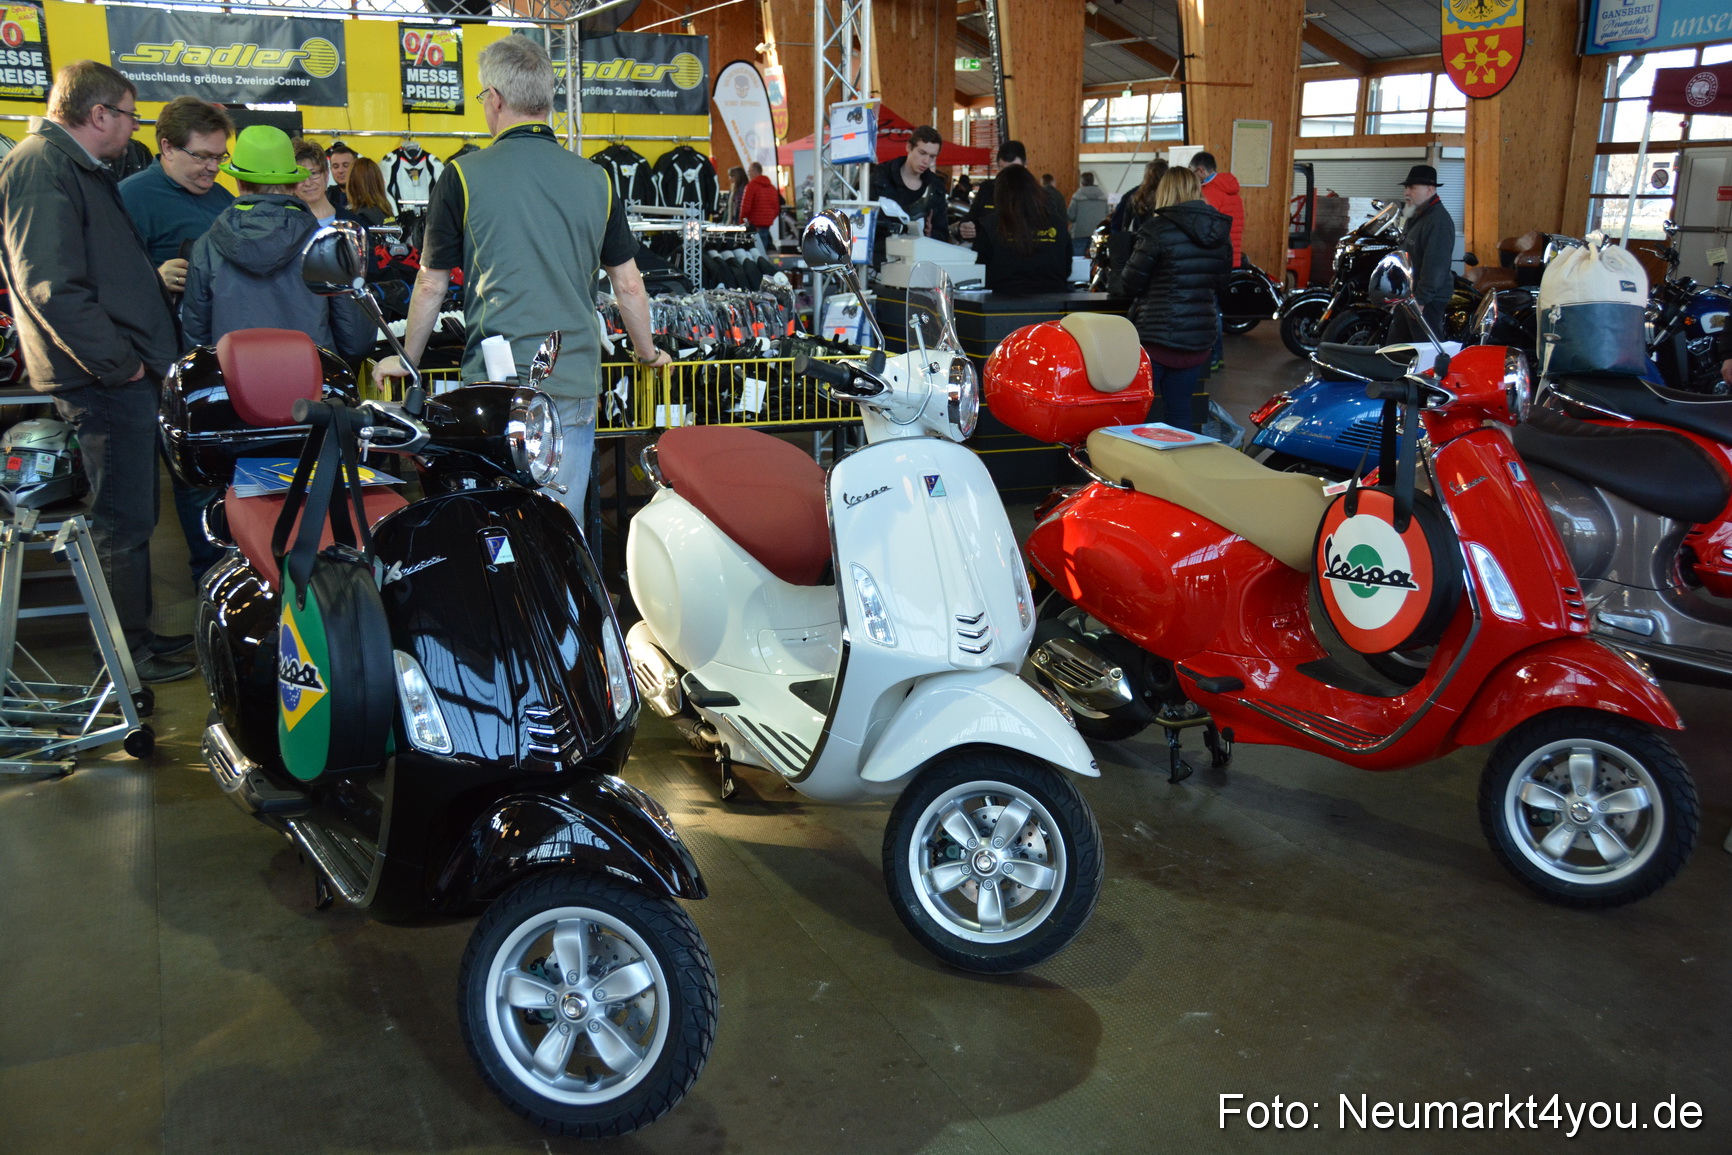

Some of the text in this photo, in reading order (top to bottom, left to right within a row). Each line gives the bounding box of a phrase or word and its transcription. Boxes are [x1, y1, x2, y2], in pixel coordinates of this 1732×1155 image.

[0, 49, 44, 67] ESSE
[119, 39, 310, 68] stadler
[120, 70, 311, 87] Deutschlands größtes Zweirad-Center
[406, 68, 458, 84] MESSE
[406, 84, 460, 100] PREISE
[582, 88, 614, 100] größtes
[615, 87, 678, 98] Zweirad-Center
[843, 485, 893, 509] Vespa
[1323, 535, 1418, 589] Vespa
